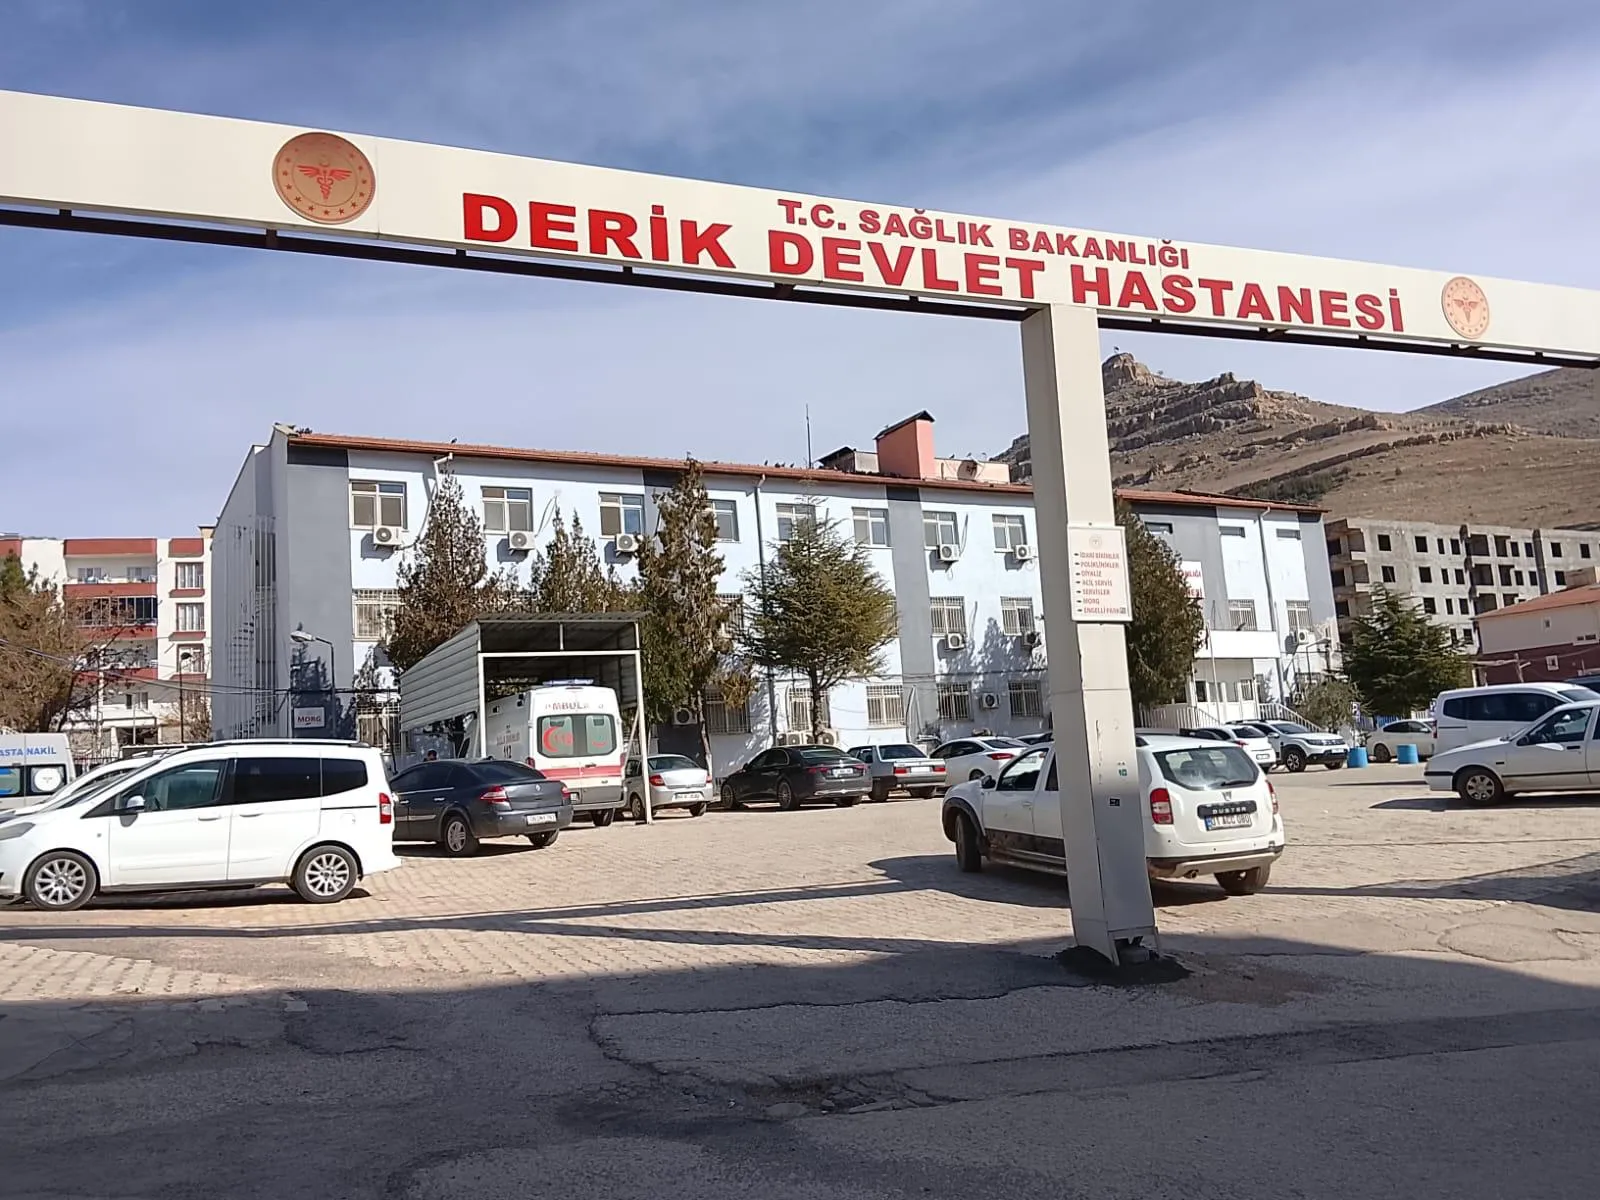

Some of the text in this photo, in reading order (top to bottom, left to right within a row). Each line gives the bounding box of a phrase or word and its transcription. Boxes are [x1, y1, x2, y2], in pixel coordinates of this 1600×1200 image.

[777, 198, 1190, 270] T.C. SAĞLIK BAKANLIĞI
[462, 192, 1404, 332] DERİK DEVLET HASTANESİ
[297, 715, 321, 723] MORG
[0, 745, 57, 756] ASTA NAKİL
